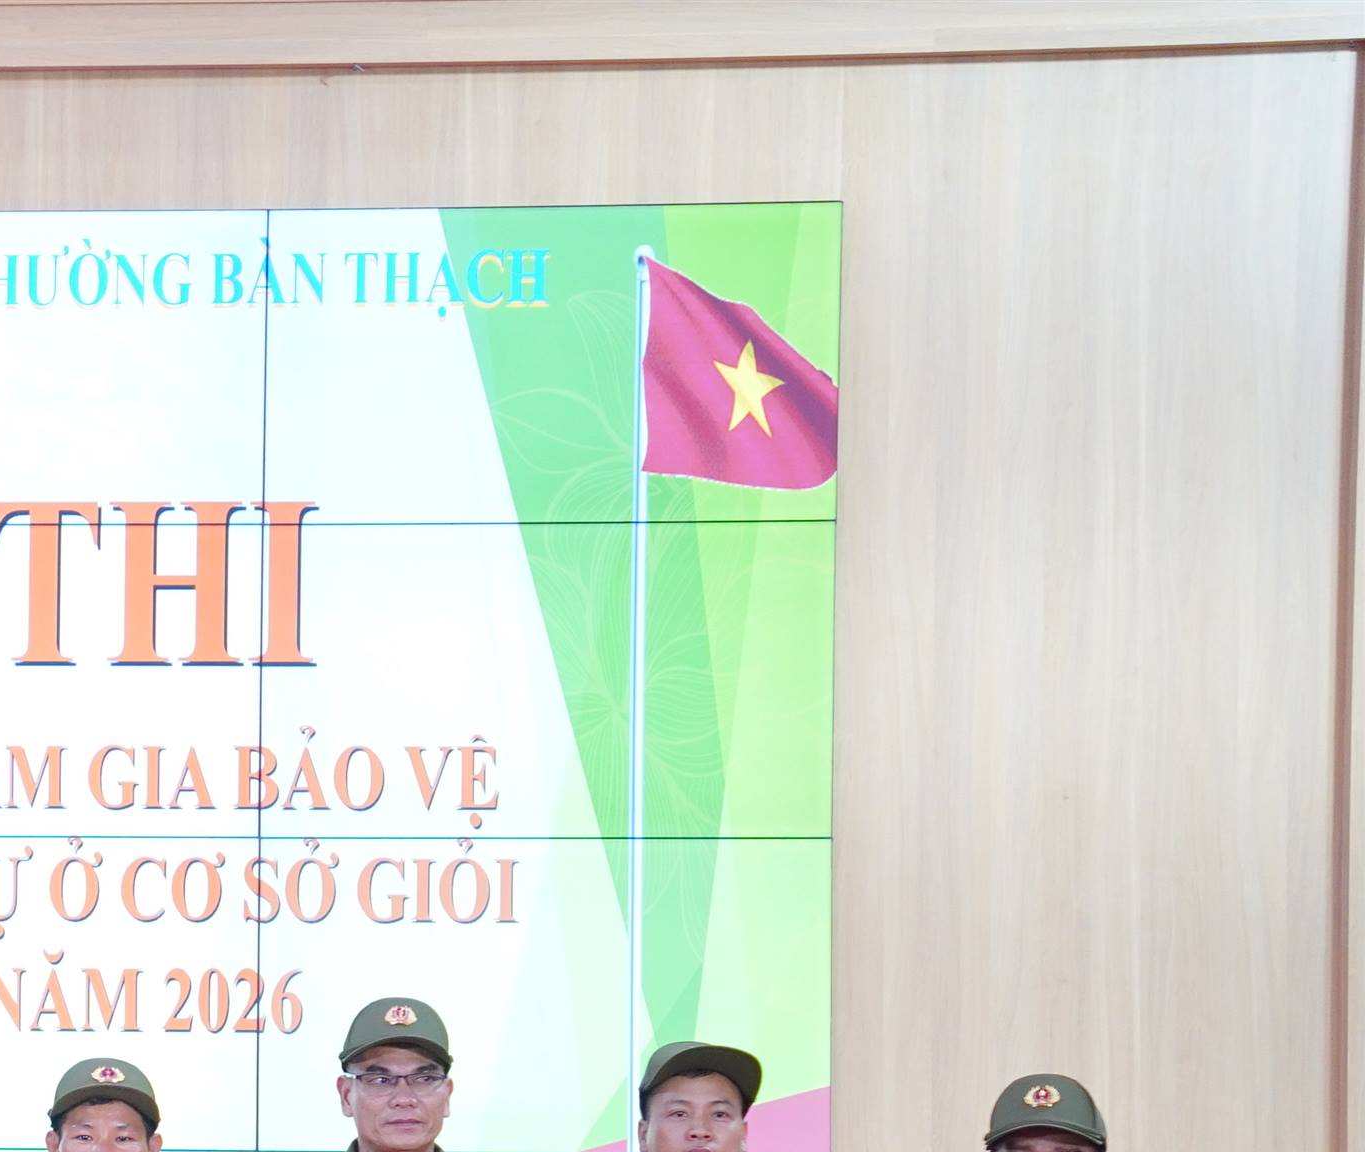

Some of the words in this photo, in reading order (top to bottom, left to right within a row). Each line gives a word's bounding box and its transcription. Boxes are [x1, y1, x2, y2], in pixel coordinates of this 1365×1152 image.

[211, 237, 325, 306] BÀN
[344, 248, 550, 317] THẠCH
[87, 744, 216, 811] GIA
[234, 725, 385, 812] BẢO
[405, 733, 499, 830] VỆ
[49, 836, 103, 924] Ở
[120, 851, 226, 924] CƠ
[242, 837, 339, 925] SỞ
[356, 837, 520, 924] GIỎI
[164, 968, 304, 1034] 2026
